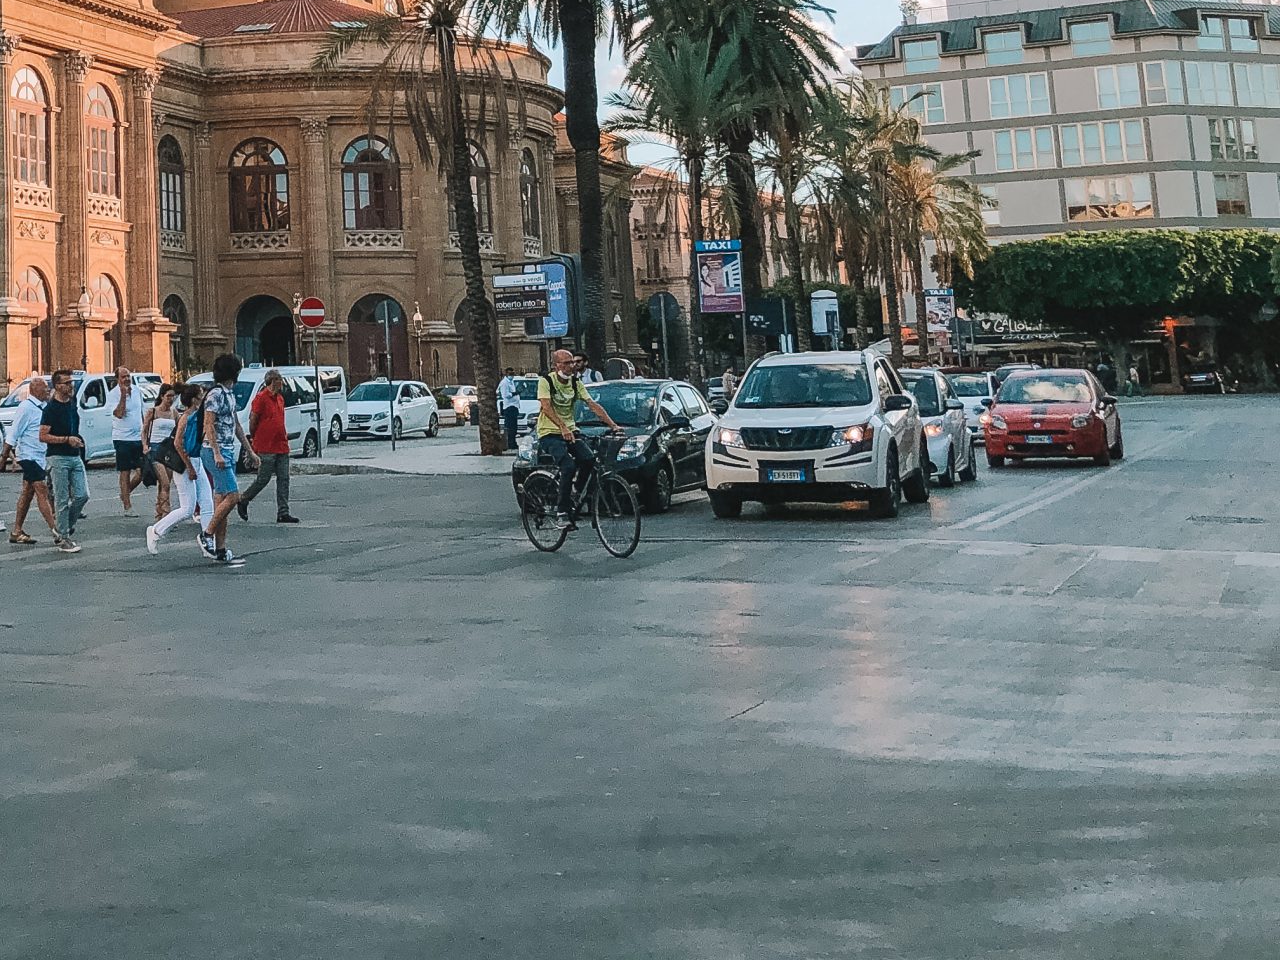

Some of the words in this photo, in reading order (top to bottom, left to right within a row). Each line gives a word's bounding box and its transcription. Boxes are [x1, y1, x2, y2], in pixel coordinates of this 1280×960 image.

[702, 241, 732, 250] TAXI
[928, 288, 948, 296] TAXI
[495, 299, 522, 309] roberto
